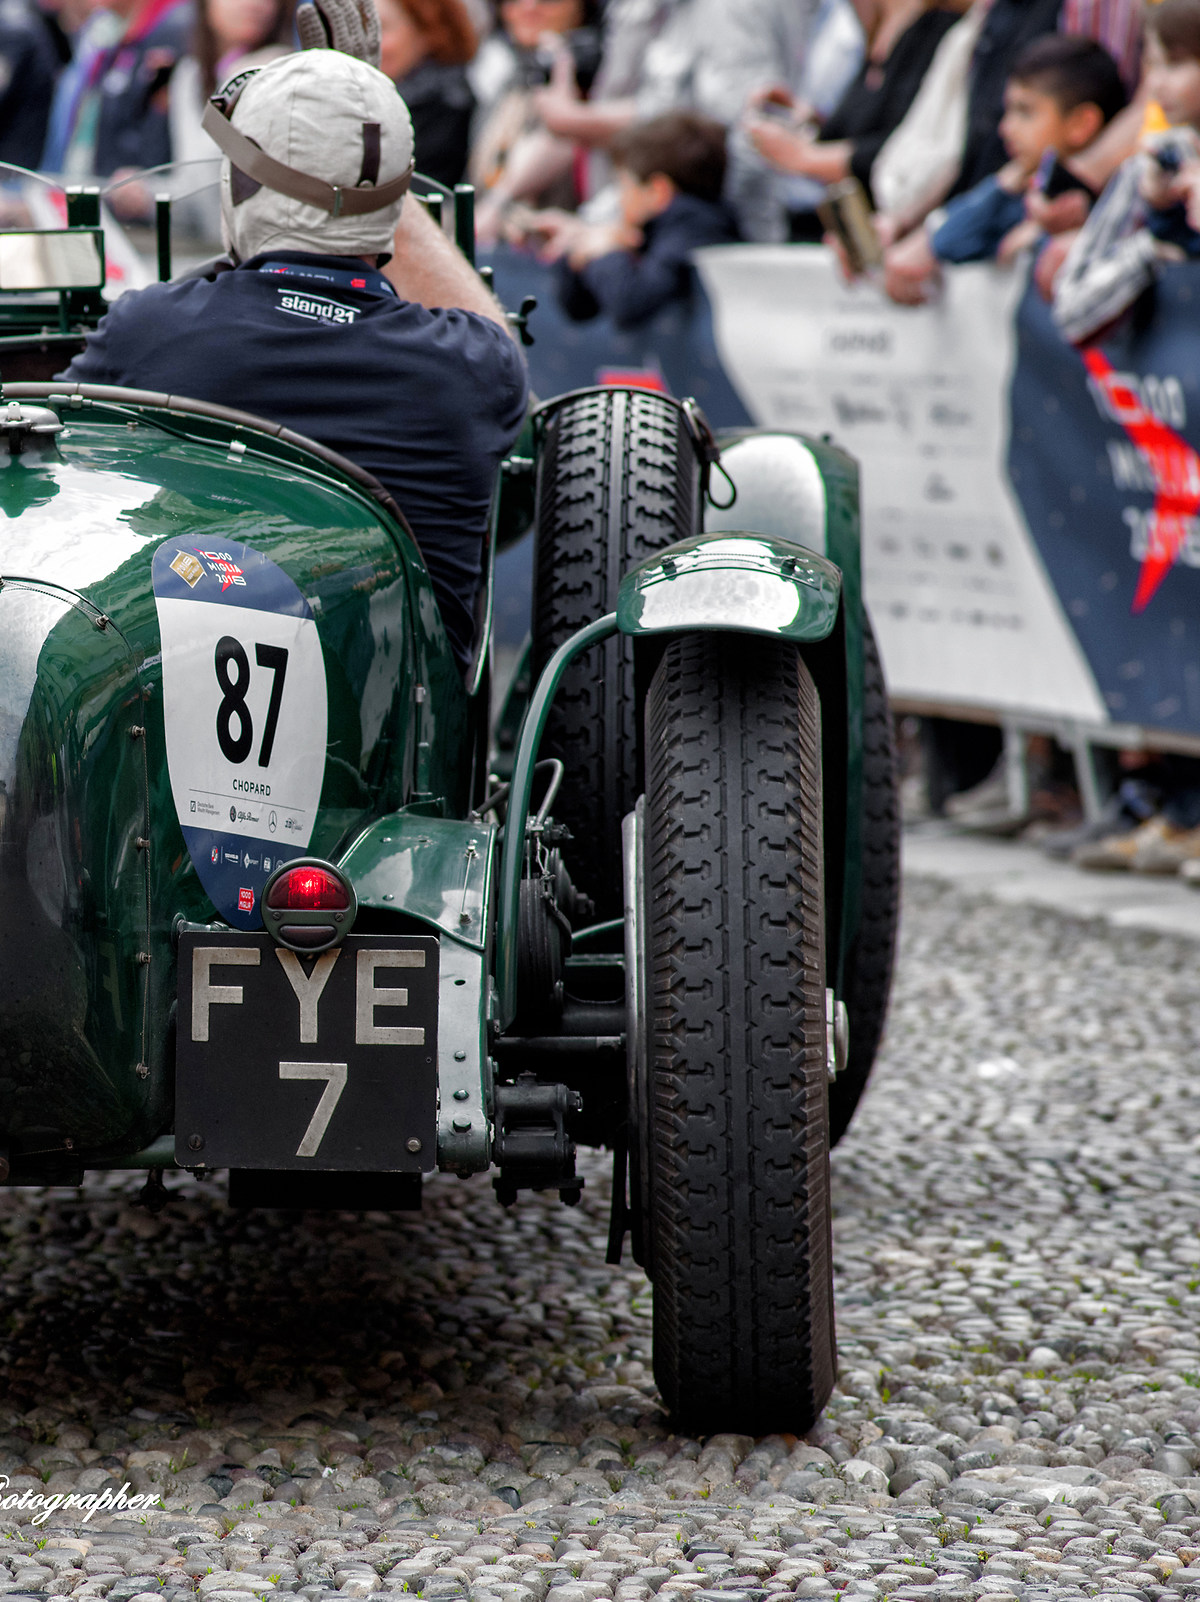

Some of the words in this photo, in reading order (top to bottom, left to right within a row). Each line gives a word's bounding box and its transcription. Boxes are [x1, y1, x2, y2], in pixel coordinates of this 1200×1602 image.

[280, 296, 355, 324] stand21
[199, 551, 233, 561] 1000
[206, 562, 242, 574] MIGLIA
[215, 573, 247, 586] 2018
[214, 635, 289, 768] 87
[232, 778, 272, 797] CHOPARD
[191, 947, 426, 1045] FYE
[279, 1061, 348, 1157] 7
